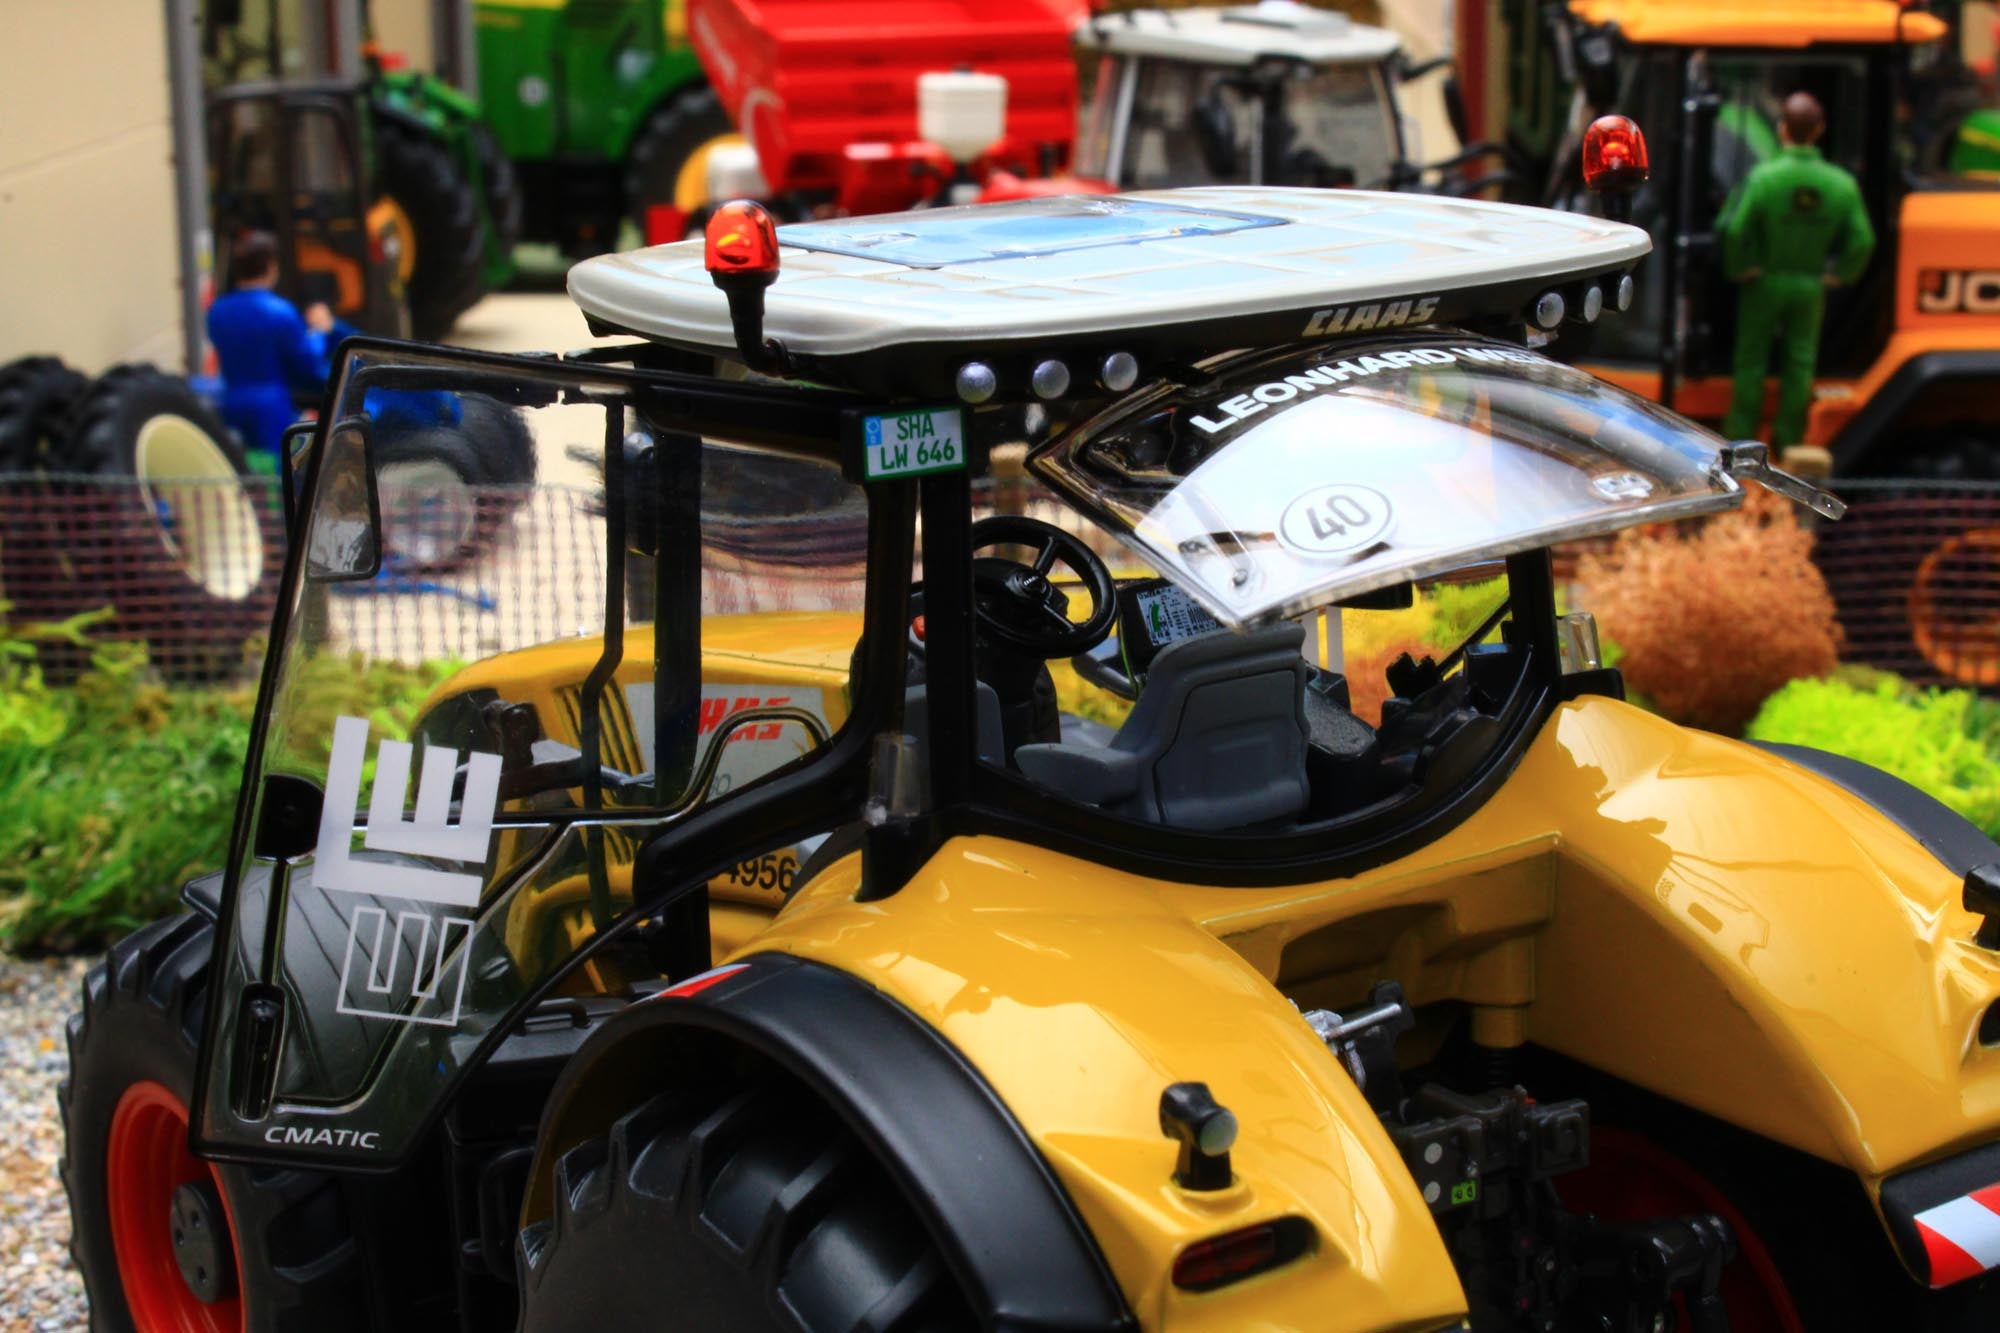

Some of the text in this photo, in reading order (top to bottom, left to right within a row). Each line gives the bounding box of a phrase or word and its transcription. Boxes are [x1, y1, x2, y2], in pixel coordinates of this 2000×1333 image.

[1302, 296, 1441, 337] CLAAS
[1189, 348, 1457, 434] LEONHARD
[896, 413, 935, 441] SHA
[880, 437, 956, 470] LW 646
[1305, 494, 1372, 541] 40
[264, 1125, 381, 1150] CMATIC
